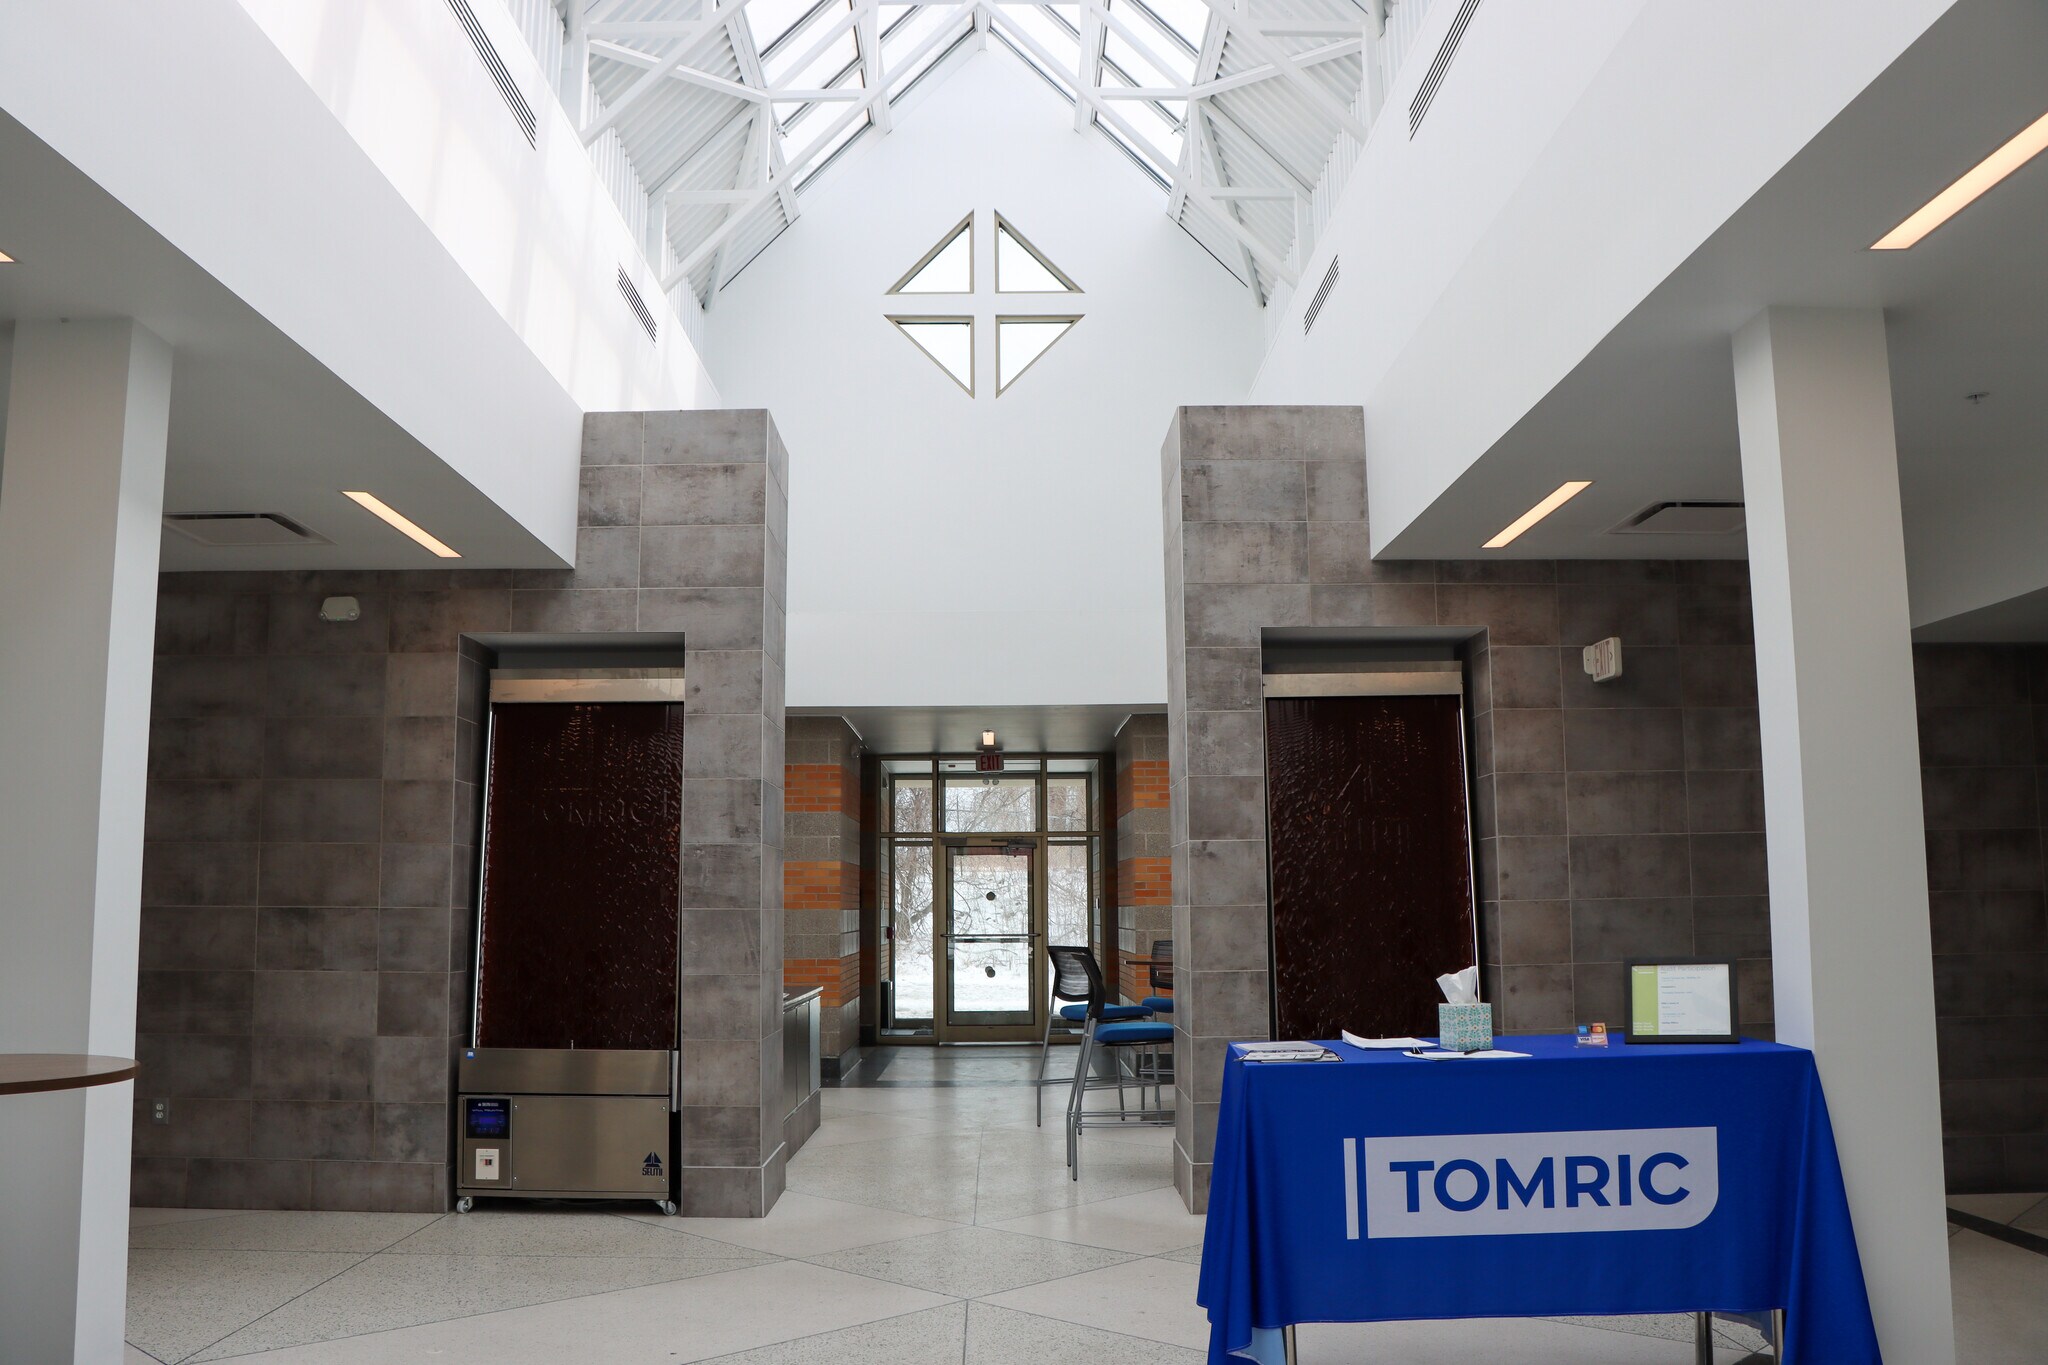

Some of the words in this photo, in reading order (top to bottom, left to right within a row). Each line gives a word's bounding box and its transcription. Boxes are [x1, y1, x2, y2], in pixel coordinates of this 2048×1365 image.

[1594, 640, 1610, 677] EXIT
[980, 753, 1000, 770] EXIT
[1389, 1152, 1690, 1213] TOMRIC
